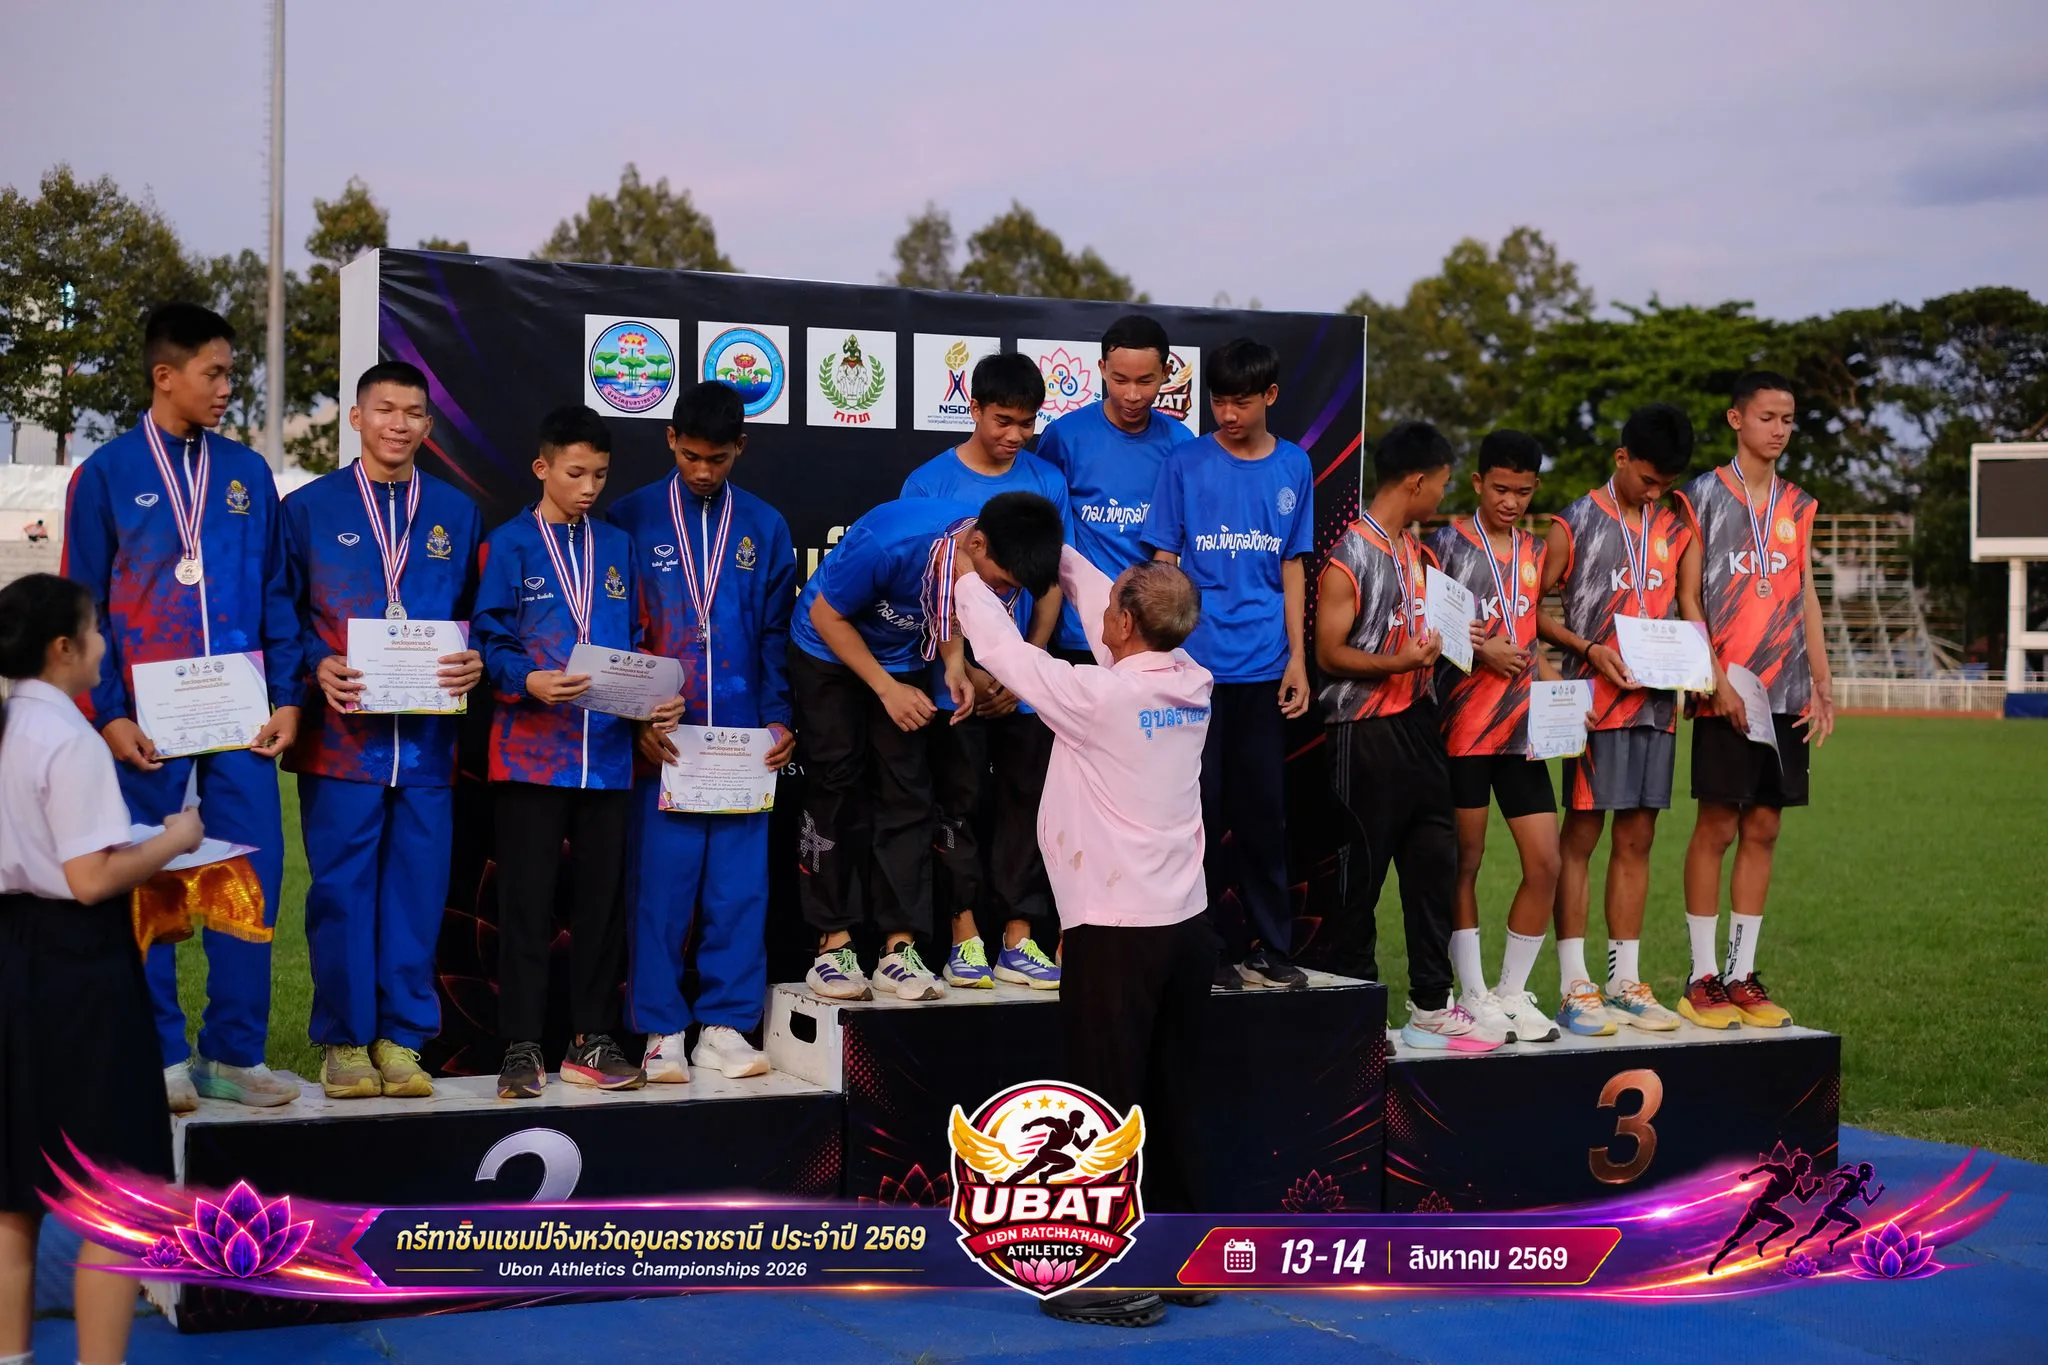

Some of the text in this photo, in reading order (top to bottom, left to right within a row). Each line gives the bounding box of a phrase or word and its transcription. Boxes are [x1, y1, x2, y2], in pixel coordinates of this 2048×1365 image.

[1611, 567, 1663, 592] KP
[1481, 594, 1530, 621] KP
[1589, 1069, 1663, 1184] 3
[475, 1127, 582, 1204] 2
